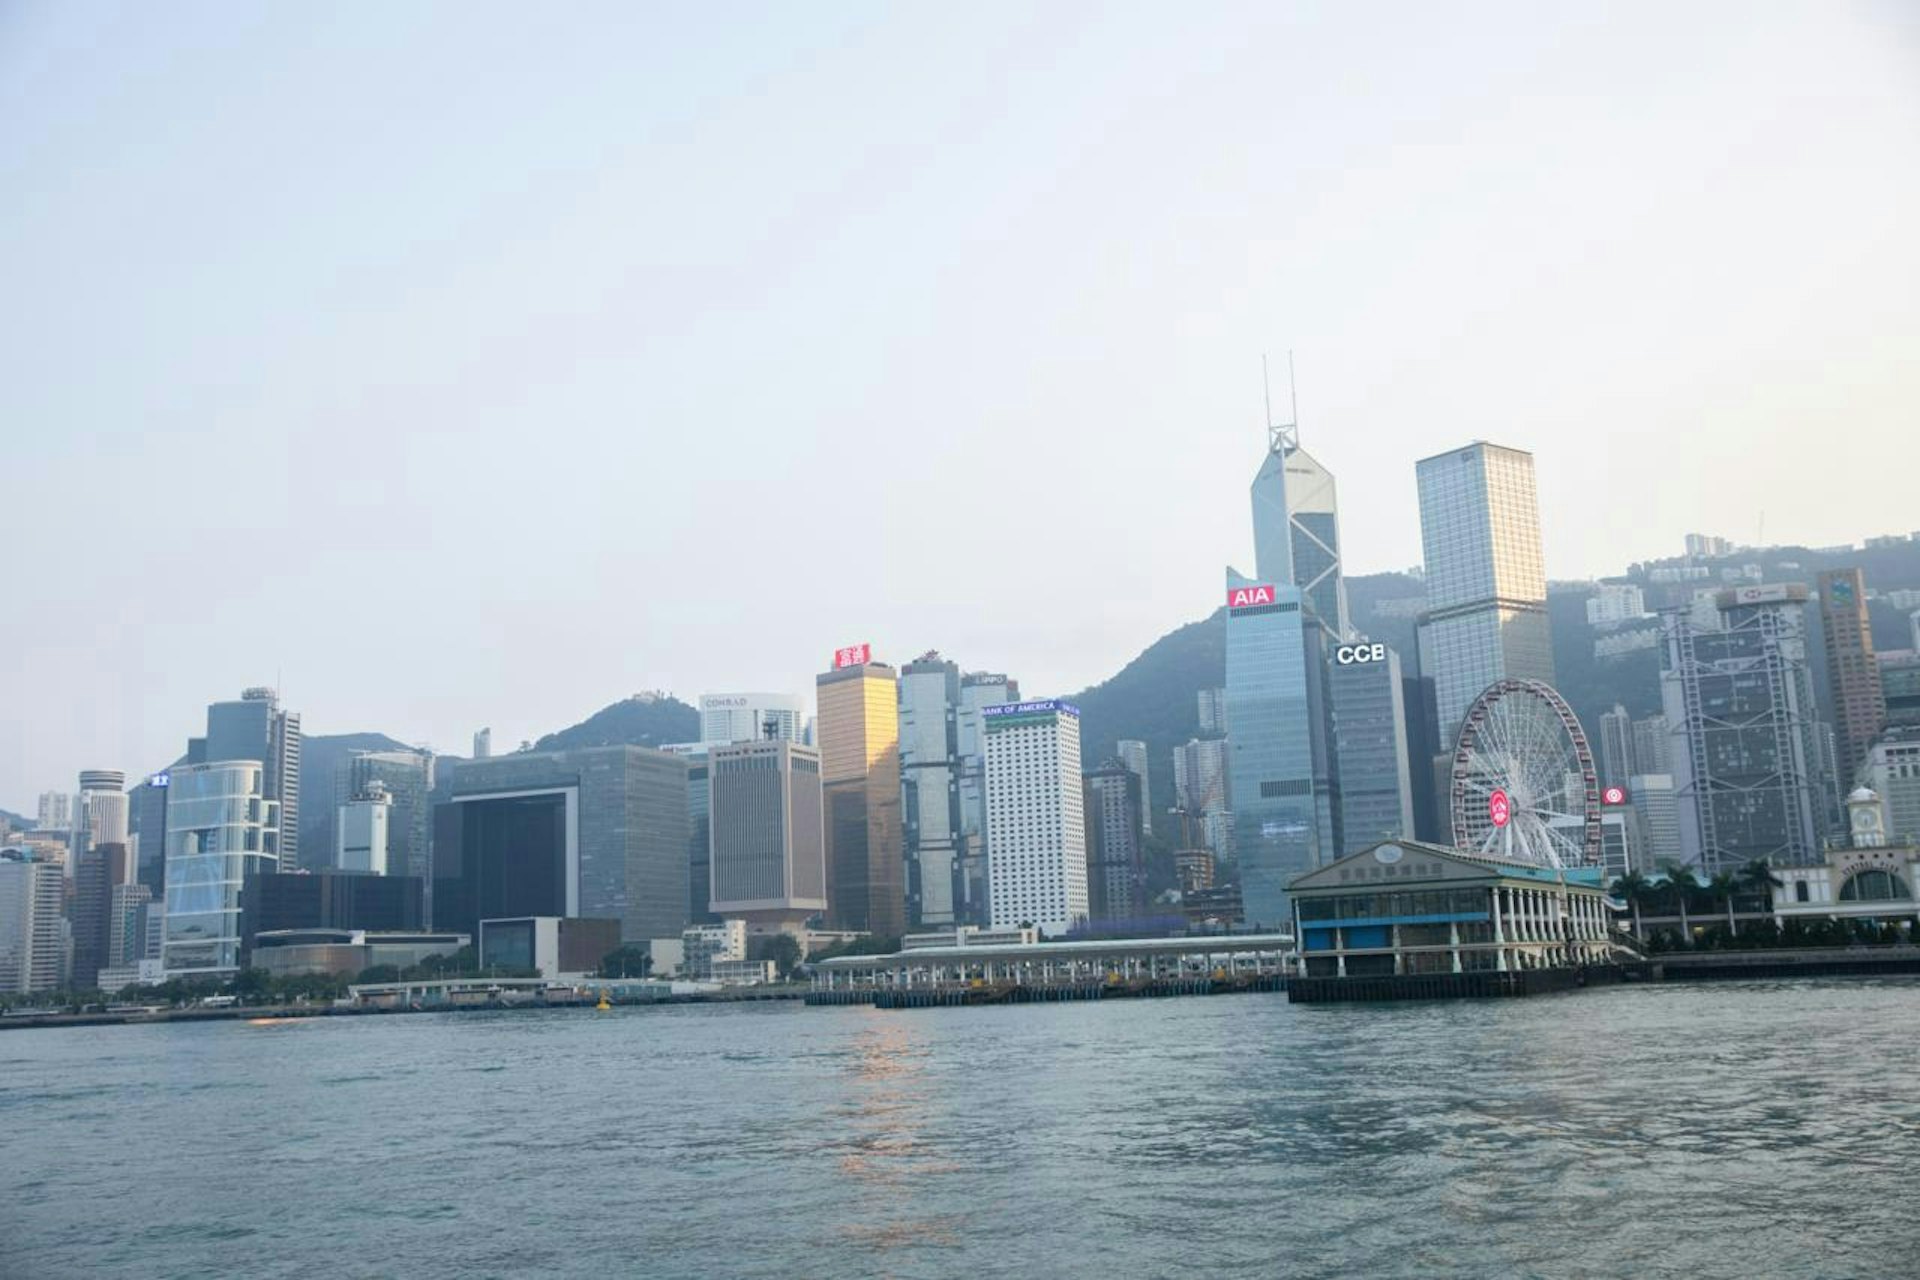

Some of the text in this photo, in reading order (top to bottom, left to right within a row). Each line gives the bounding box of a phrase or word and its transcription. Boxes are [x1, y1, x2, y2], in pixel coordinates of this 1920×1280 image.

[1234, 587, 1270, 606] AIA
[1337, 643, 1385, 665] CCB
[705, 698, 747, 708] CONRAD
[1004, 705, 1015, 713] OF
[1018, 701, 1055, 713] AMERICA
